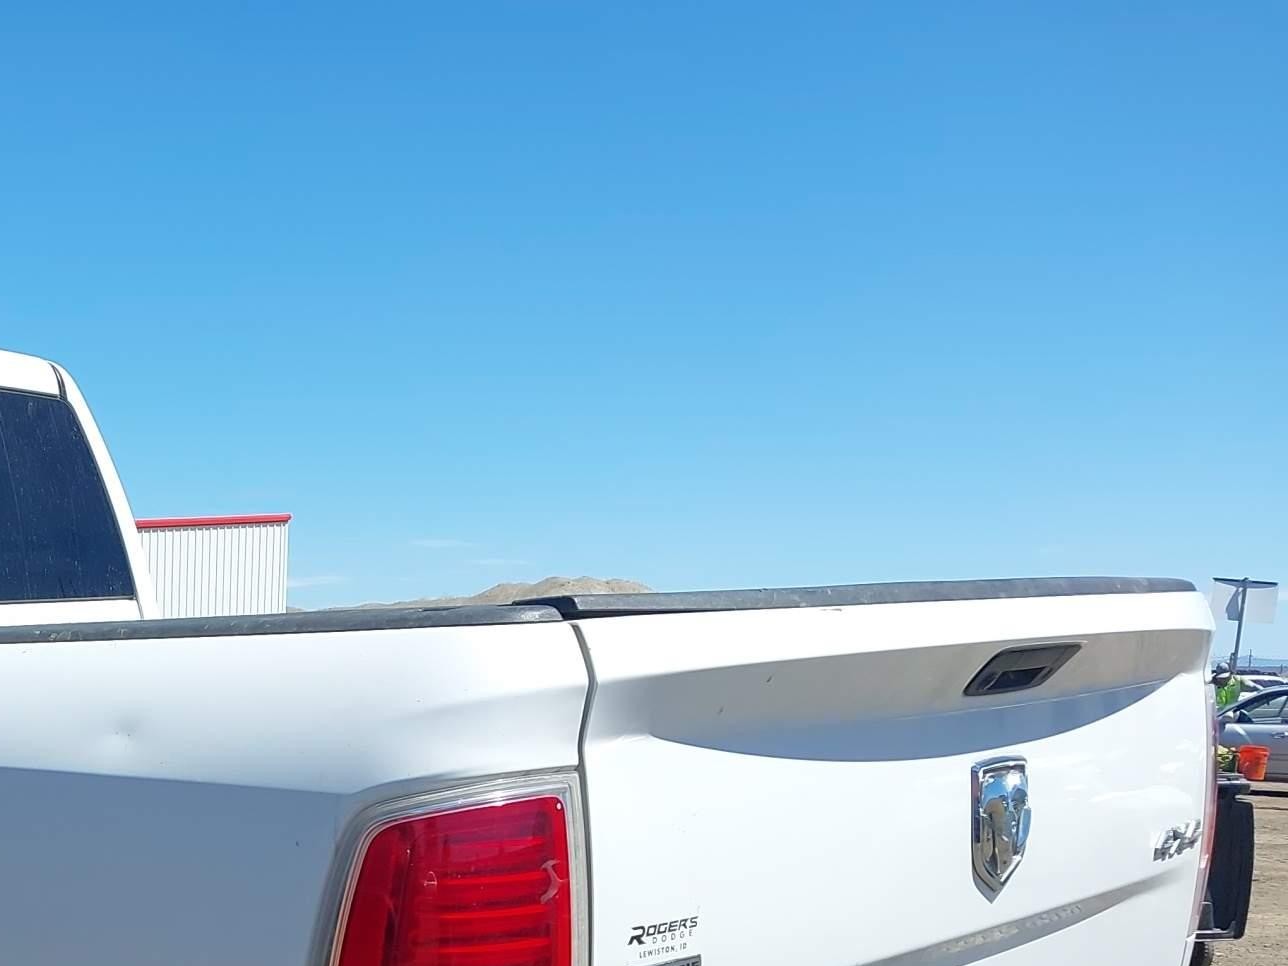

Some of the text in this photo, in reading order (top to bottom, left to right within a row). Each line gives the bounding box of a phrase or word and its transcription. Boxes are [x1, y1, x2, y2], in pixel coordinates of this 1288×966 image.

[628, 916, 698, 945] ROGERS
[652, 929, 694, 944] DODGE
[639, 946, 678, 959] LEWISTON,
